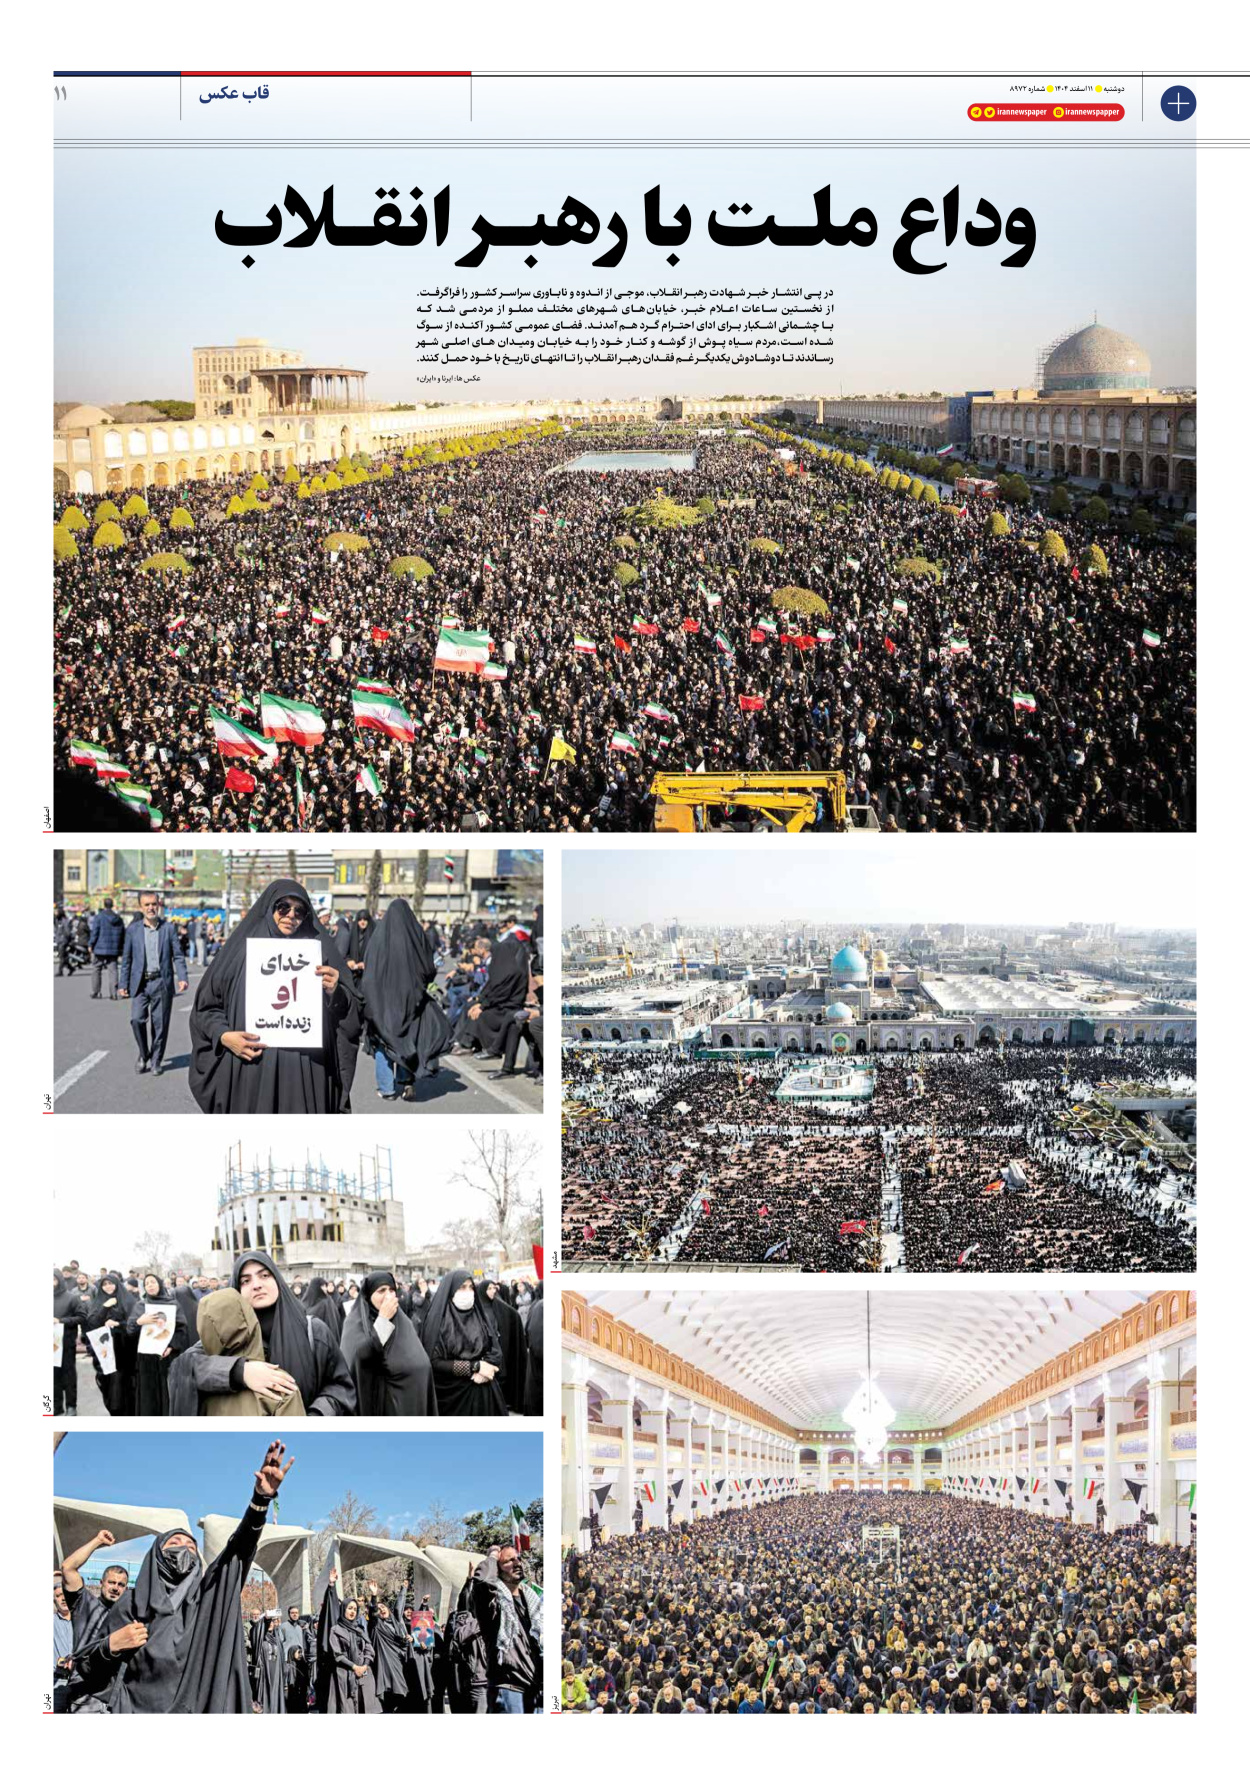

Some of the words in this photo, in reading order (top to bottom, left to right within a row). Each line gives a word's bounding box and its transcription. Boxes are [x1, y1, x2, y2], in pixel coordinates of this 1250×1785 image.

[54, 86, 67, 101] ۱۱
[199, 86, 240, 104] عکس
[243, 84, 270, 104] قاب
[1028, 85, 1045, 94] شماره
[1104, 85, 1125, 94] دوشنبه
[997, 107, 1047, 117] irannewspaper
[1065, 107, 1119, 117] irannewspapper
[708, 184, 878, 247] ملت
[215, 184, 450, 267] انقلاب
[644, 184, 691, 267] با
[893, 184, 1036, 275] وداع
[454, 195, 628, 268] رهبر
[461, 287, 469, 300] را
[470, 288, 497, 299] کشور
[498, 288, 531, 299] سراسر
[533, 288, 567, 299] ناباوری
[568, 290, 575, 300] و
[576, 288, 603, 299] اندوه
[604, 288, 612, 299] از
[614, 291, 644, 300] موجی
[683, 290, 707, 299] رهبر
[709, 288, 745, 299] شهادت
[747, 288, 769, 299] خبر
[771, 288, 802, 299] انتشار
[804, 291, 822, 300] پی
[823, 290, 833, 299] در
[417, 304, 432, 312] که
[496, 303, 505, 316] از
[508, 304, 533, 315] مملو
[537, 304, 573, 312] مختلف
[577, 304, 617, 315] شهرهای
[710, 304, 738, 315] اعلام
[742, 304, 777, 312] ساعات
[781, 304, 822, 315] نخستین
[826, 304, 834, 315] از
[417, 319, 443, 332] سوگ
[444, 320, 453, 333] از
[455, 320, 483, 329] آکنده
[485, 321, 512, 332] کشور
[515, 323, 549, 333] عمومی
[552, 320, 582, 331] فضای
[585, 320, 618, 329] آمدند.
[619, 323, 638, 331] هم
[640, 319, 659, 332] گرد
[662, 321, 694, 332] احترام
[696, 321, 715, 331] ادای
[718, 321, 741, 332] برای
[743, 321, 776, 332] اشکبار
[779, 321, 819, 333] چشمانی
[822, 321, 834, 331] با
[415, 338, 438, 348] شهر
[441, 337, 469, 349] اصلی
[537, 337, 572, 348] خیابان
[575, 339, 589, 348] به
[591, 336, 598, 349] را
[600, 337, 623, 348] خود
[625, 337, 648, 348] کنار
[649, 339, 656, 349] و
[658, 336, 686, 348] گوشه
[688, 337, 696, 348] از
[699, 338, 726, 349] پوش
[728, 337, 753, 348] سیاه
[417, 353, 439, 362] کنند.
[441, 353, 468, 364] حمل
[470, 354, 492, 365] خود
[493, 352, 501, 365] با
[502, 354, 529, 365] تاریخ
[531, 354, 563, 364] انتهای
[564, 353, 575, 362] تا
[576, 352, 584, 366] را
[585, 353, 618, 364] انقلاب
[617, 355, 641, 365] رهبر
[643, 353, 674, 364] فقدان
[676, 353, 695, 364] غم
[694, 352, 730, 365] یکدیگر
[731, 353, 780, 365] دوشادوش
[782, 353, 794, 362] تا
[795, 353, 833, 365] رساندند
[441, 374, 454, 384] ایرنا
[463, 374, 482, 384] عکس
[43, 806, 52, 829] اصفهان
[261, 953, 310, 976] خدای
[271, 977, 298, 1010] او
[43, 1093, 52, 1111] تهران
[552, 1251, 560, 1269] مشهد
[42, 1394, 52, 1413] گرگان
[43, 1693, 52, 1710] تهران
[551, 1695, 560, 1711] تبریز
